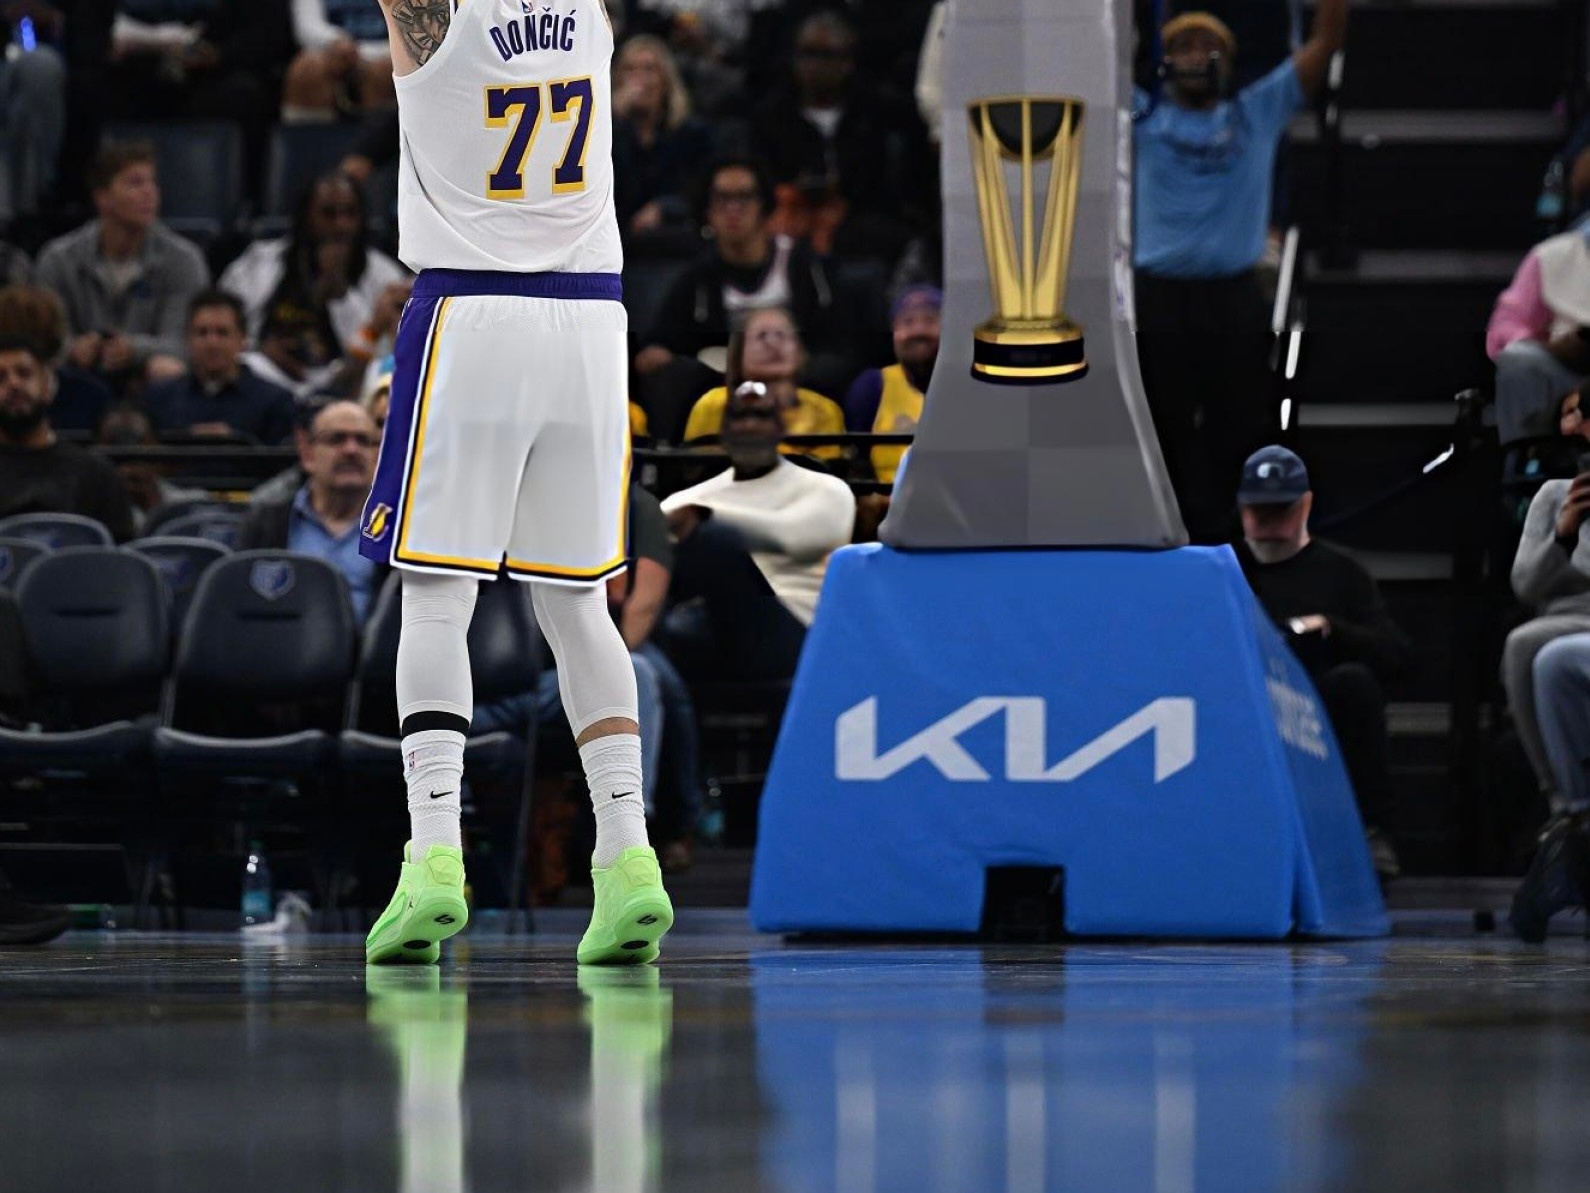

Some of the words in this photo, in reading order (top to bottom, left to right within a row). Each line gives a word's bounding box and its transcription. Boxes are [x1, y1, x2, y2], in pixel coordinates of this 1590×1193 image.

[489, 7, 577, 63] DONČIĆ
[484, 75, 595, 200] 77
[834, 695, 1196, 784] KIA
